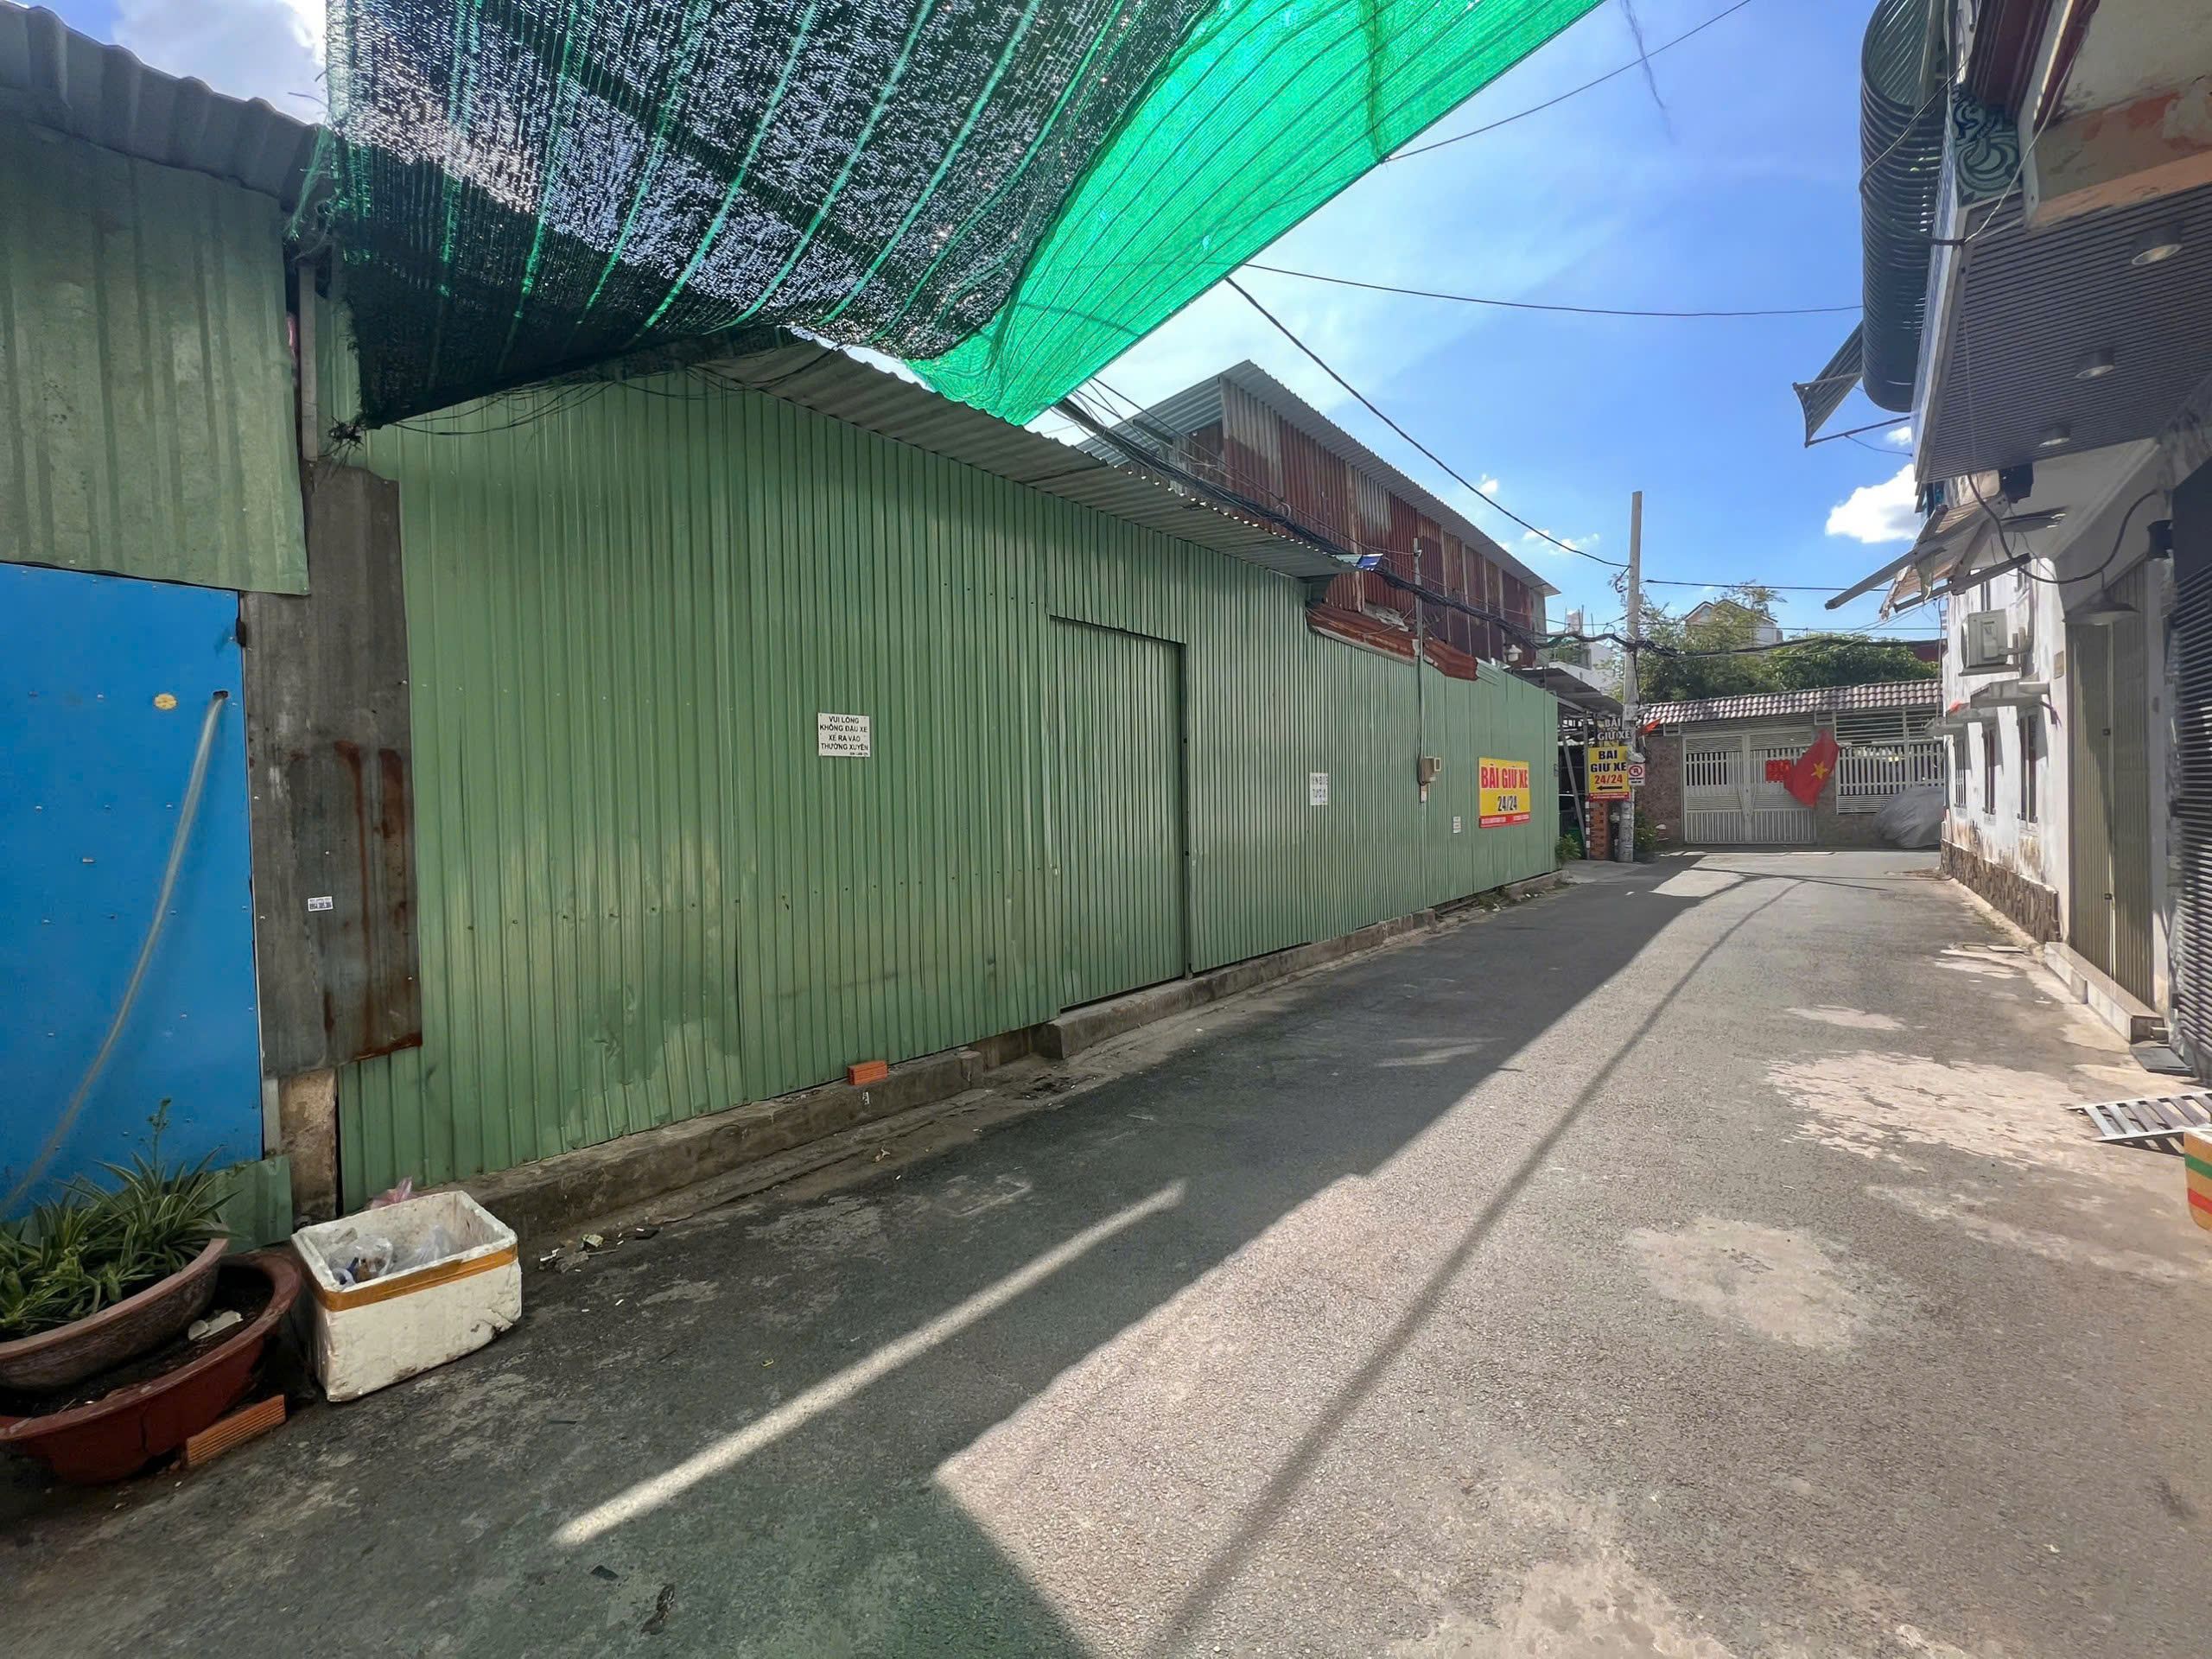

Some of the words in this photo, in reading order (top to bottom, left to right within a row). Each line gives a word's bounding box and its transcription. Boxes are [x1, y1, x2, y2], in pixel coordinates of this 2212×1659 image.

[1618, 730, 1630, 740] XE
[1613, 762, 1627, 772] XE
[1481, 763, 1499, 789] BÃI
[1519, 769, 1529, 789] XE
[1594, 774, 1623, 785] 24/24
[1497, 795, 1517, 812] 24/24
